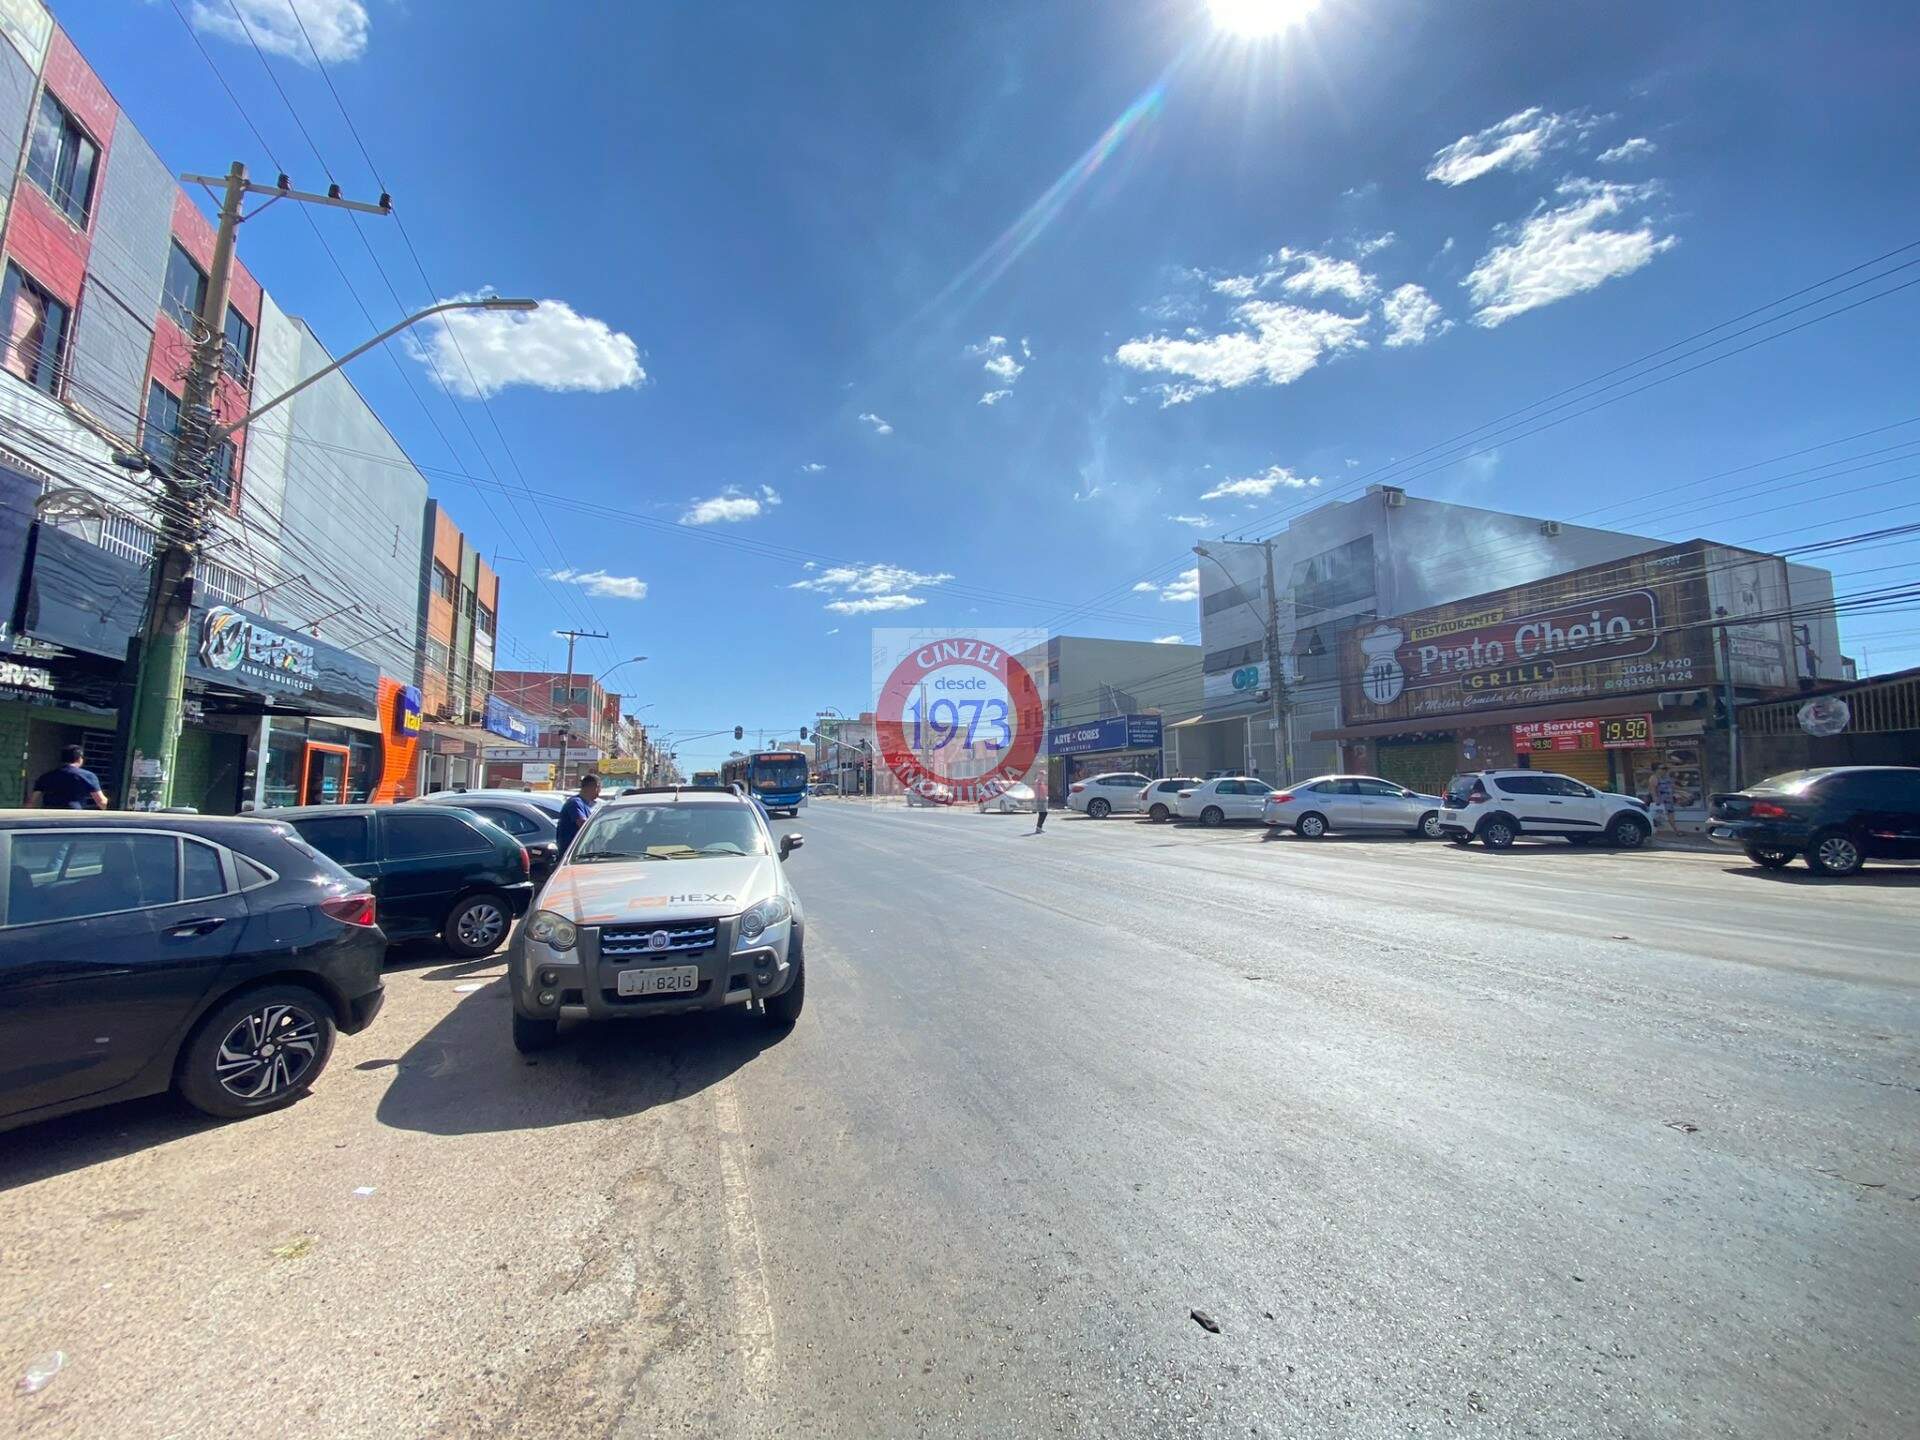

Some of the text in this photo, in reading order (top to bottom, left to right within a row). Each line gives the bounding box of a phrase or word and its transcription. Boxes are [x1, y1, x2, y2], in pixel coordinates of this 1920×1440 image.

[1415, 613, 1499, 639] RESTAURANTE
[1418, 611, 1632, 678] Prato Cheio
[1623, 658, 1692, 675] 3028-7420
[1471, 666, 1543, 688] GRILL
[1616, 670, 1693, 688] 98356-1424
[1515, 720, 1594, 733] Self Service
[1606, 720, 1647, 740] 19.90
[669, 893, 737, 903] HEXA
